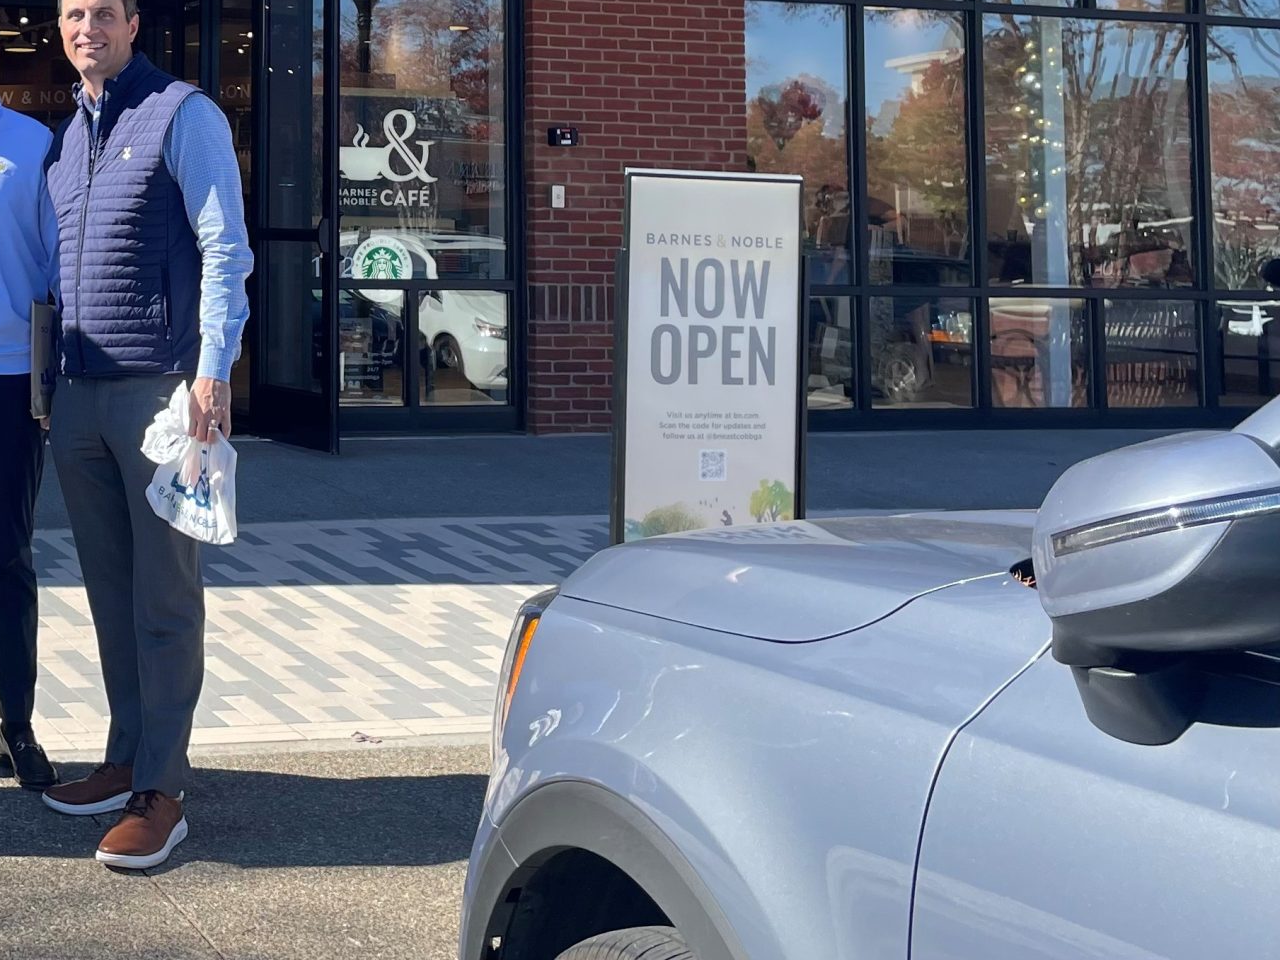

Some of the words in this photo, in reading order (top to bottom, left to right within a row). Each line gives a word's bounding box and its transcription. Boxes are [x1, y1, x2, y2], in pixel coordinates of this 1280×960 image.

[343, 197, 378, 206] NOBLE
[380, 185, 430, 207] CAFÉ
[646, 232, 712, 247] BARNES
[716, 234, 727, 248] &
[731, 236, 783, 249] NOBLE
[660, 256, 771, 319] NOW
[650, 323, 776, 386] OPEN
[666, 411, 683, 419] Visit
[694, 411, 723, 421] anytime
[659, 422, 677, 430] Scan
[678, 422, 690, 430] the
[692, 422, 710, 430] code
[711, 422, 721, 430] for
[723, 422, 751, 431] updates
[662, 432, 685, 440] follow
